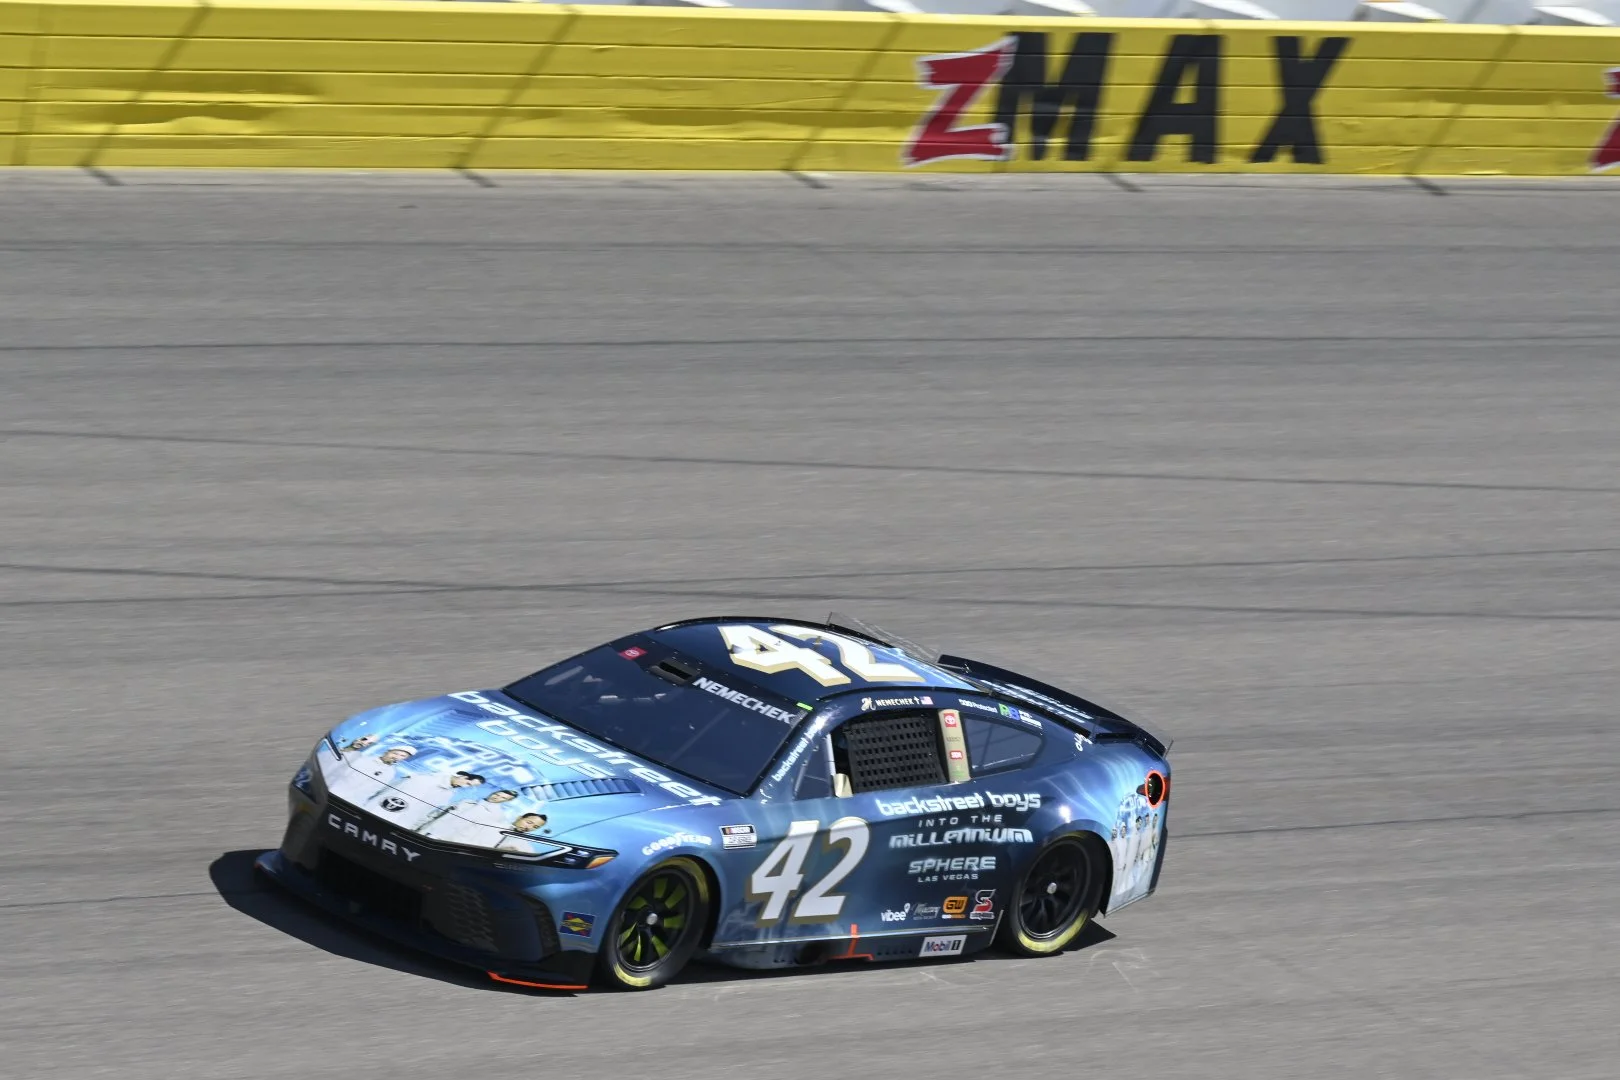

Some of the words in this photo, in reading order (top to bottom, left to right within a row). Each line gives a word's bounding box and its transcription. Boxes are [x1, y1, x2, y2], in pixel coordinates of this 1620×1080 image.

[718, 624, 927, 687] 42
[693, 677, 797, 725] NEMECHEK
[875, 698, 915, 707] NEMECHEK
[876, 793, 984, 816] backstreet
[986, 791, 1042, 812] boys
[918, 816, 959, 828] INTO
[971, 814, 1003, 823] THE
[327, 814, 421, 862] CAMRY
[745, 816, 870, 929] 42
[907, 856, 997, 875] SPHERE
[943, 873, 979, 881] VEGAS
[924, 941, 952, 953] Mobil
